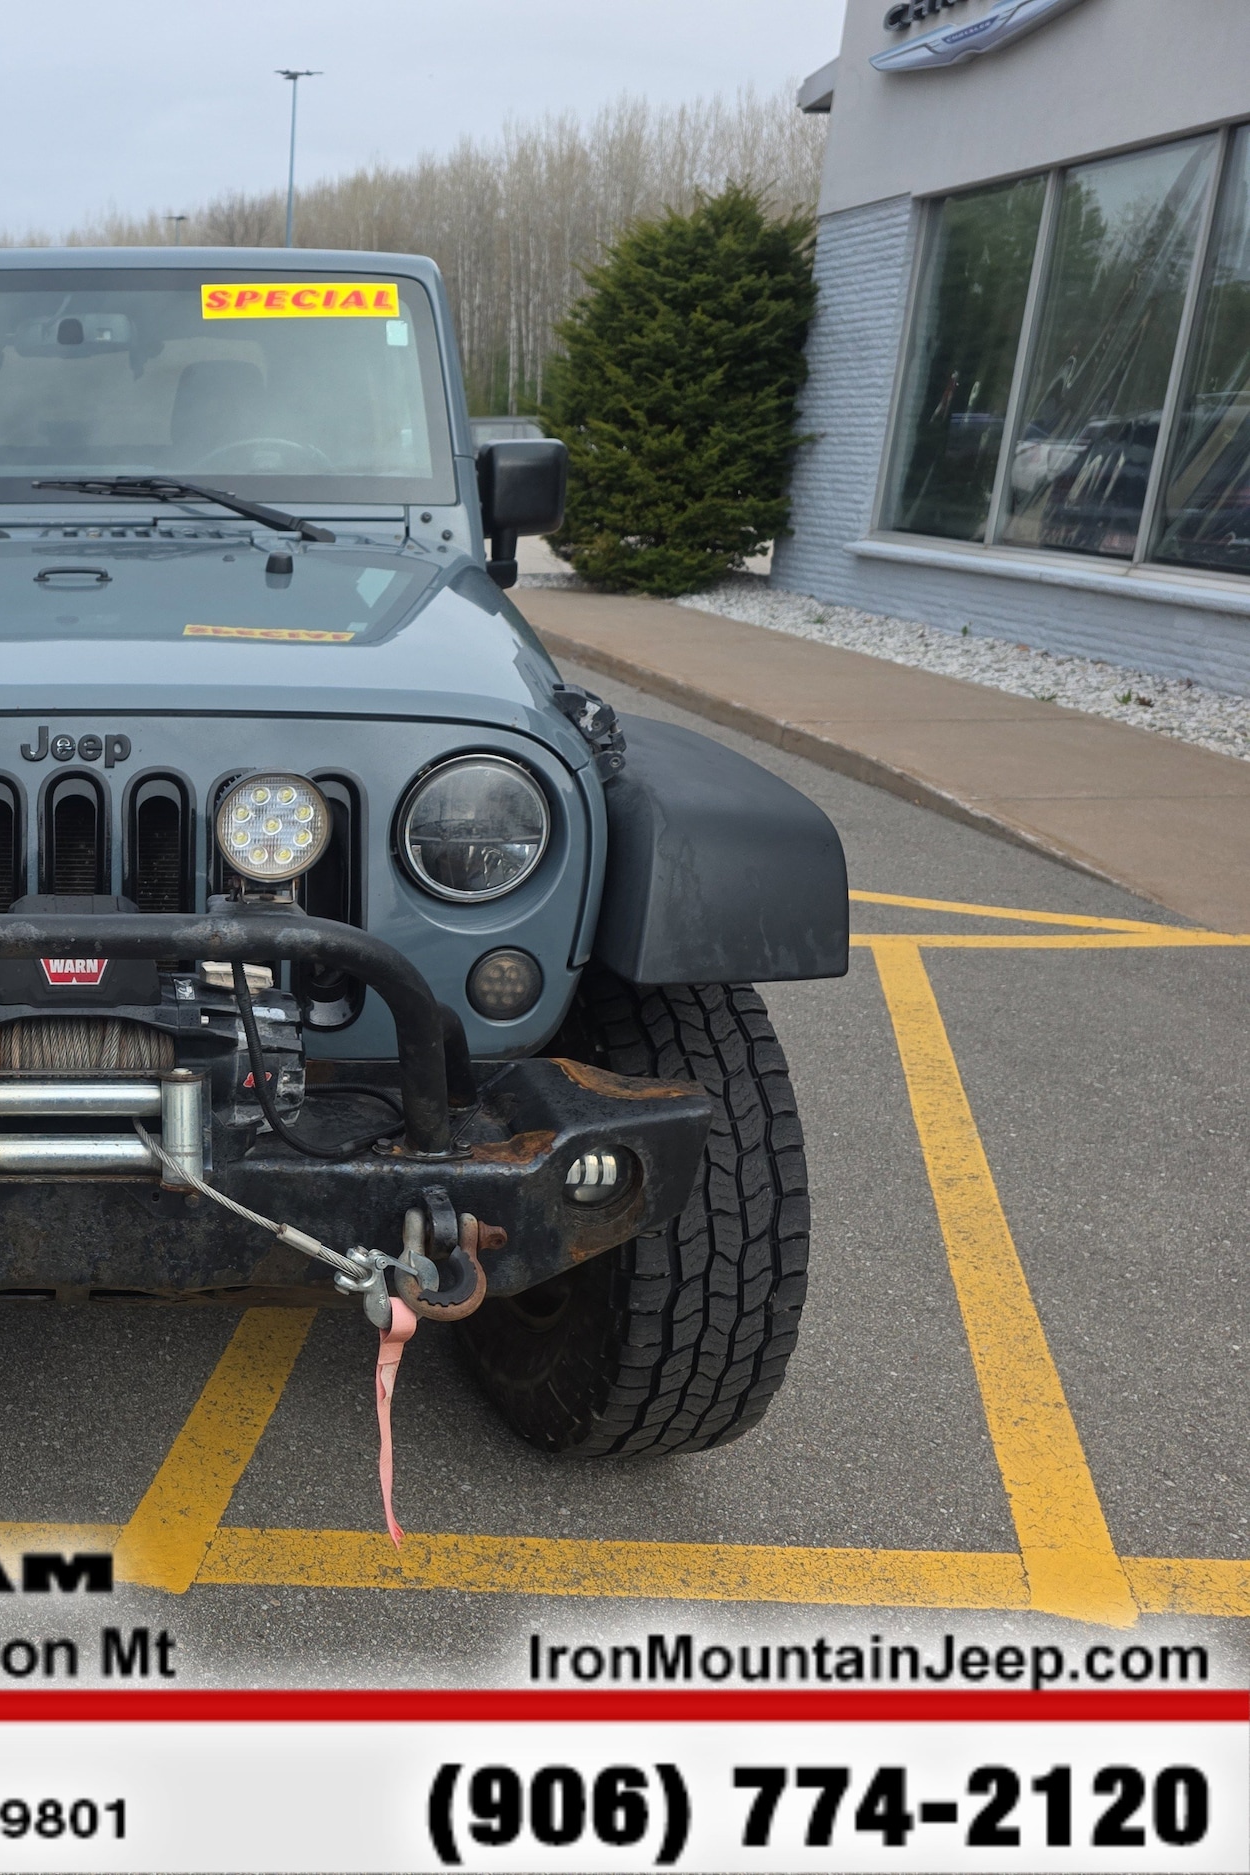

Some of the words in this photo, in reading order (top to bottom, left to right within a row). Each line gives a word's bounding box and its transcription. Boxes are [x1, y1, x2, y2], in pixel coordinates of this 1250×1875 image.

[205, 289, 394, 311] SPECIAL
[20, 725, 132, 769] Jeep
[49, 958, 98, 973] WARN
